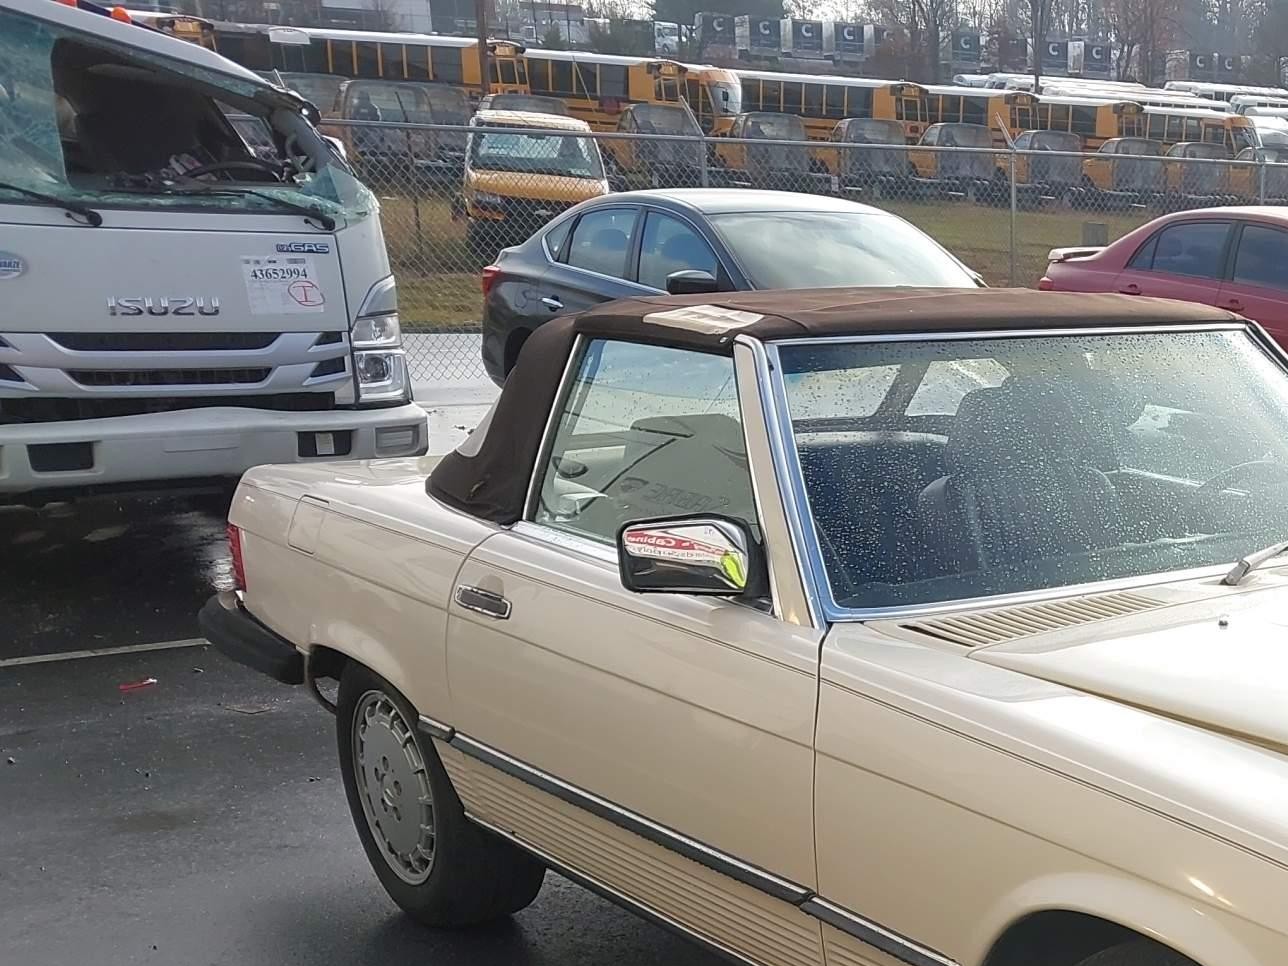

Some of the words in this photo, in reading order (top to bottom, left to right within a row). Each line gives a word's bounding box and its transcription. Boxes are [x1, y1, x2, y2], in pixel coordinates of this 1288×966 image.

[759, 21, 770, 34] C
[801, 24, 813, 37] C
[843, 27, 854, 40] C
[1091, 47, 1102, 59] C
[290, 243, 329, 252] GAS
[250, 267, 308, 280] 43652994
[107, 297, 220, 316] ISUZU
